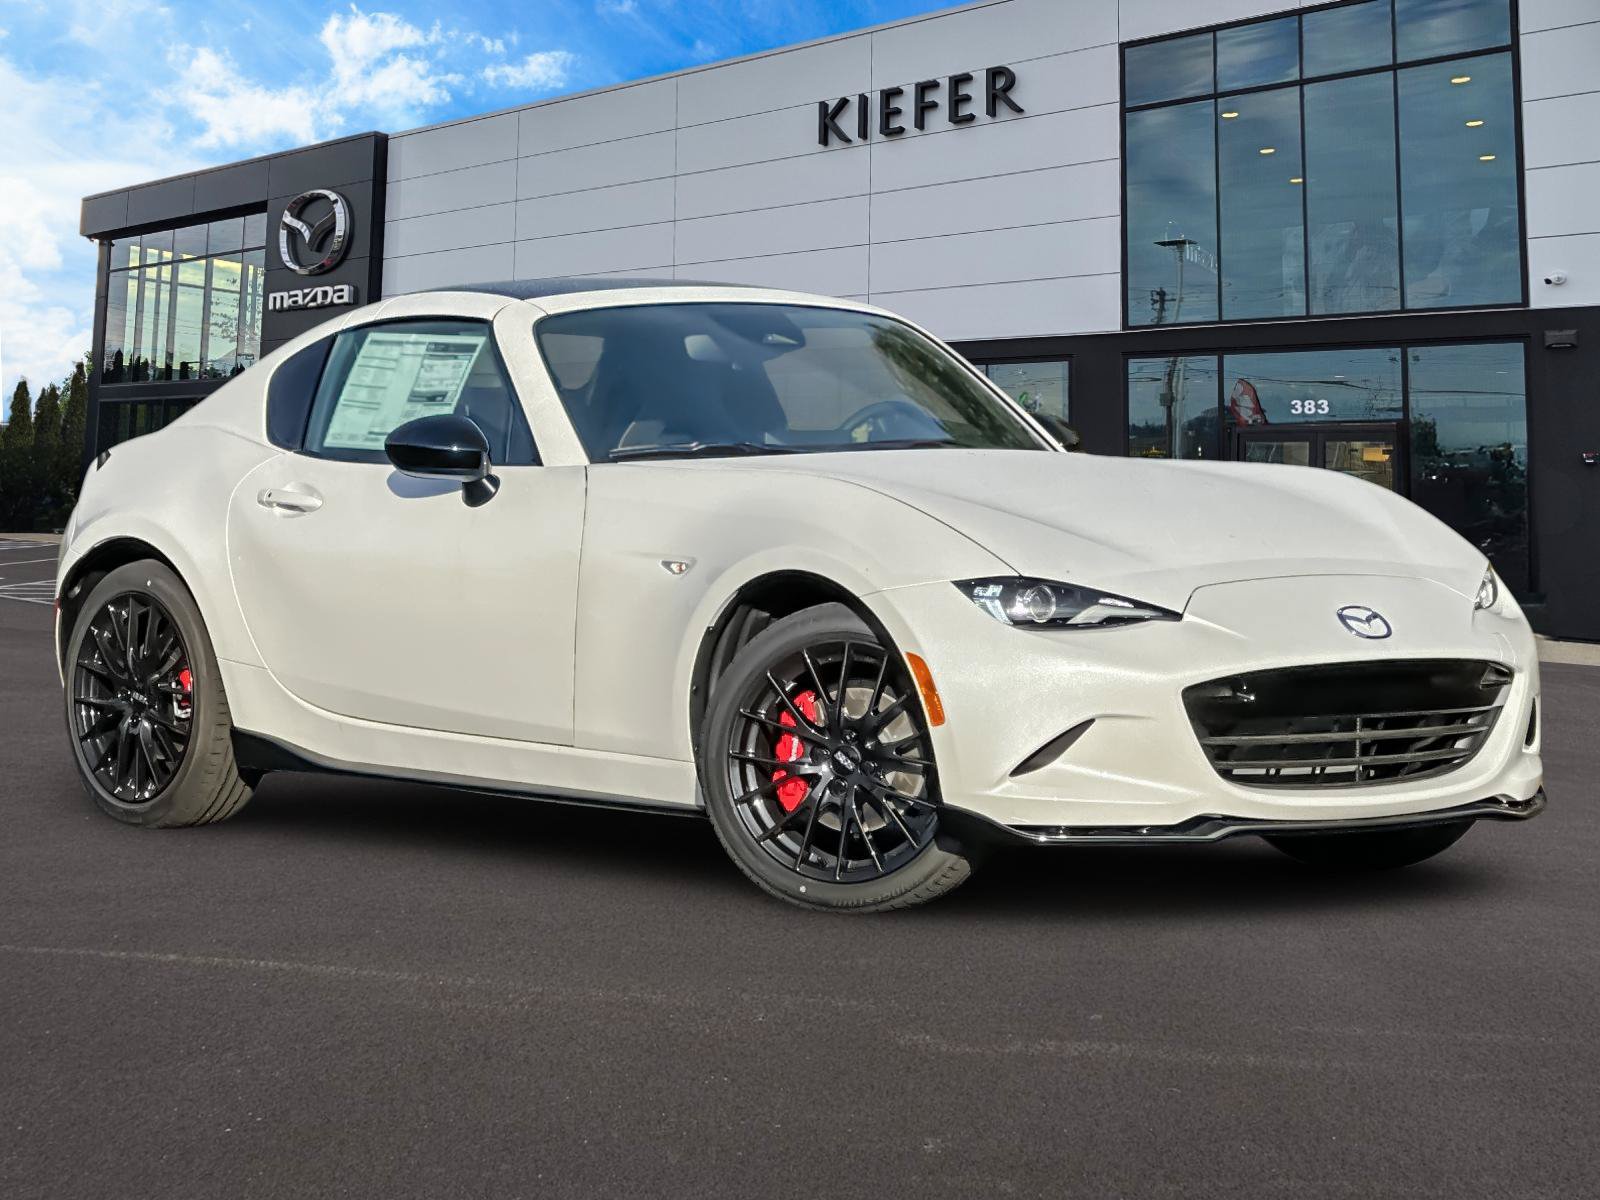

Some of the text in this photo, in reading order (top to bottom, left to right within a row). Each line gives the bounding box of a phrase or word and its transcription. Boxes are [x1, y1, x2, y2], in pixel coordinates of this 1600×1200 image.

[818, 66, 1024, 146] KIEFER
[268, 284, 353, 311] mazda
[1291, 400, 1329, 414] 383
